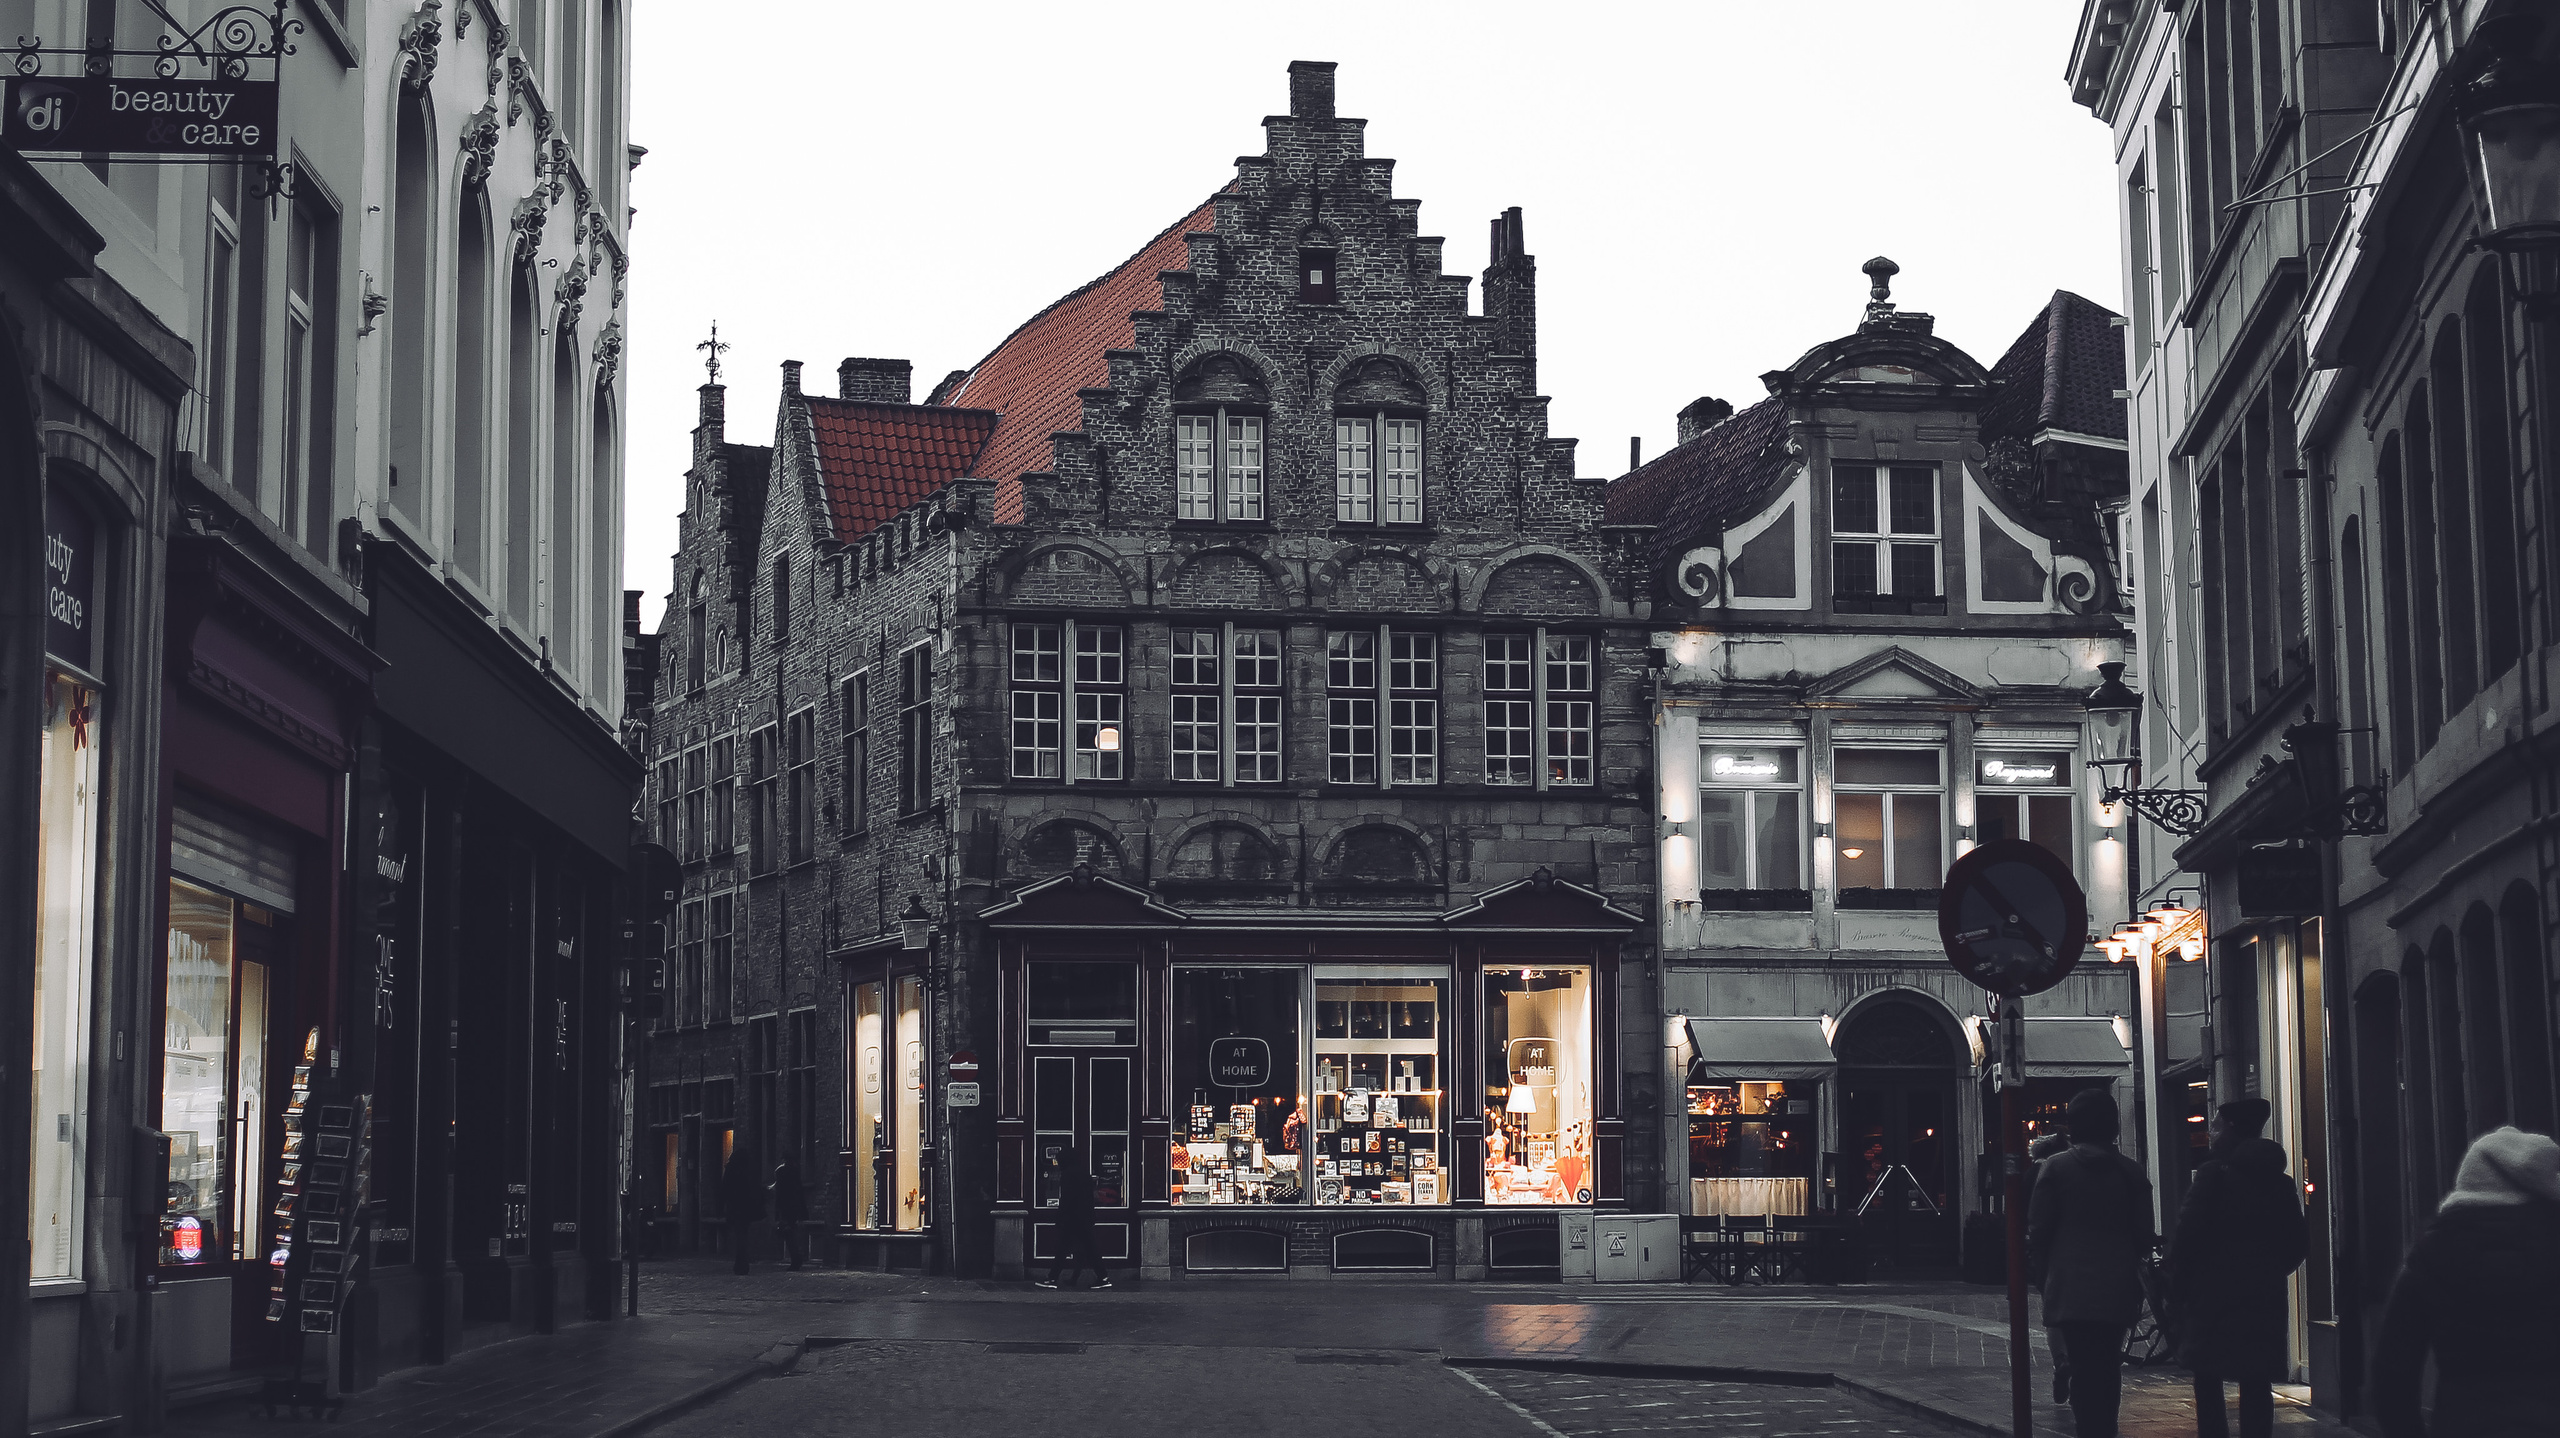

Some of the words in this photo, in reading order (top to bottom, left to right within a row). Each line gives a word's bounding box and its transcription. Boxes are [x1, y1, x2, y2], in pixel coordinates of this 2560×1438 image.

[109, 84, 235, 120] beauty
[26, 97, 62, 131] di
[146, 116, 177, 144] &
[181, 123, 260, 146] care
[50, 586, 82, 630] care
[1233, 1047, 1247, 1058] AT
[1530, 1048, 1545, 1059] AT
[1222, 1065, 1258, 1076] HOME
[1520, 1065, 1555, 1077] HOME
[1417, 1182, 1434, 1190] CORN
[1356, 1190, 1366, 1199] NO
